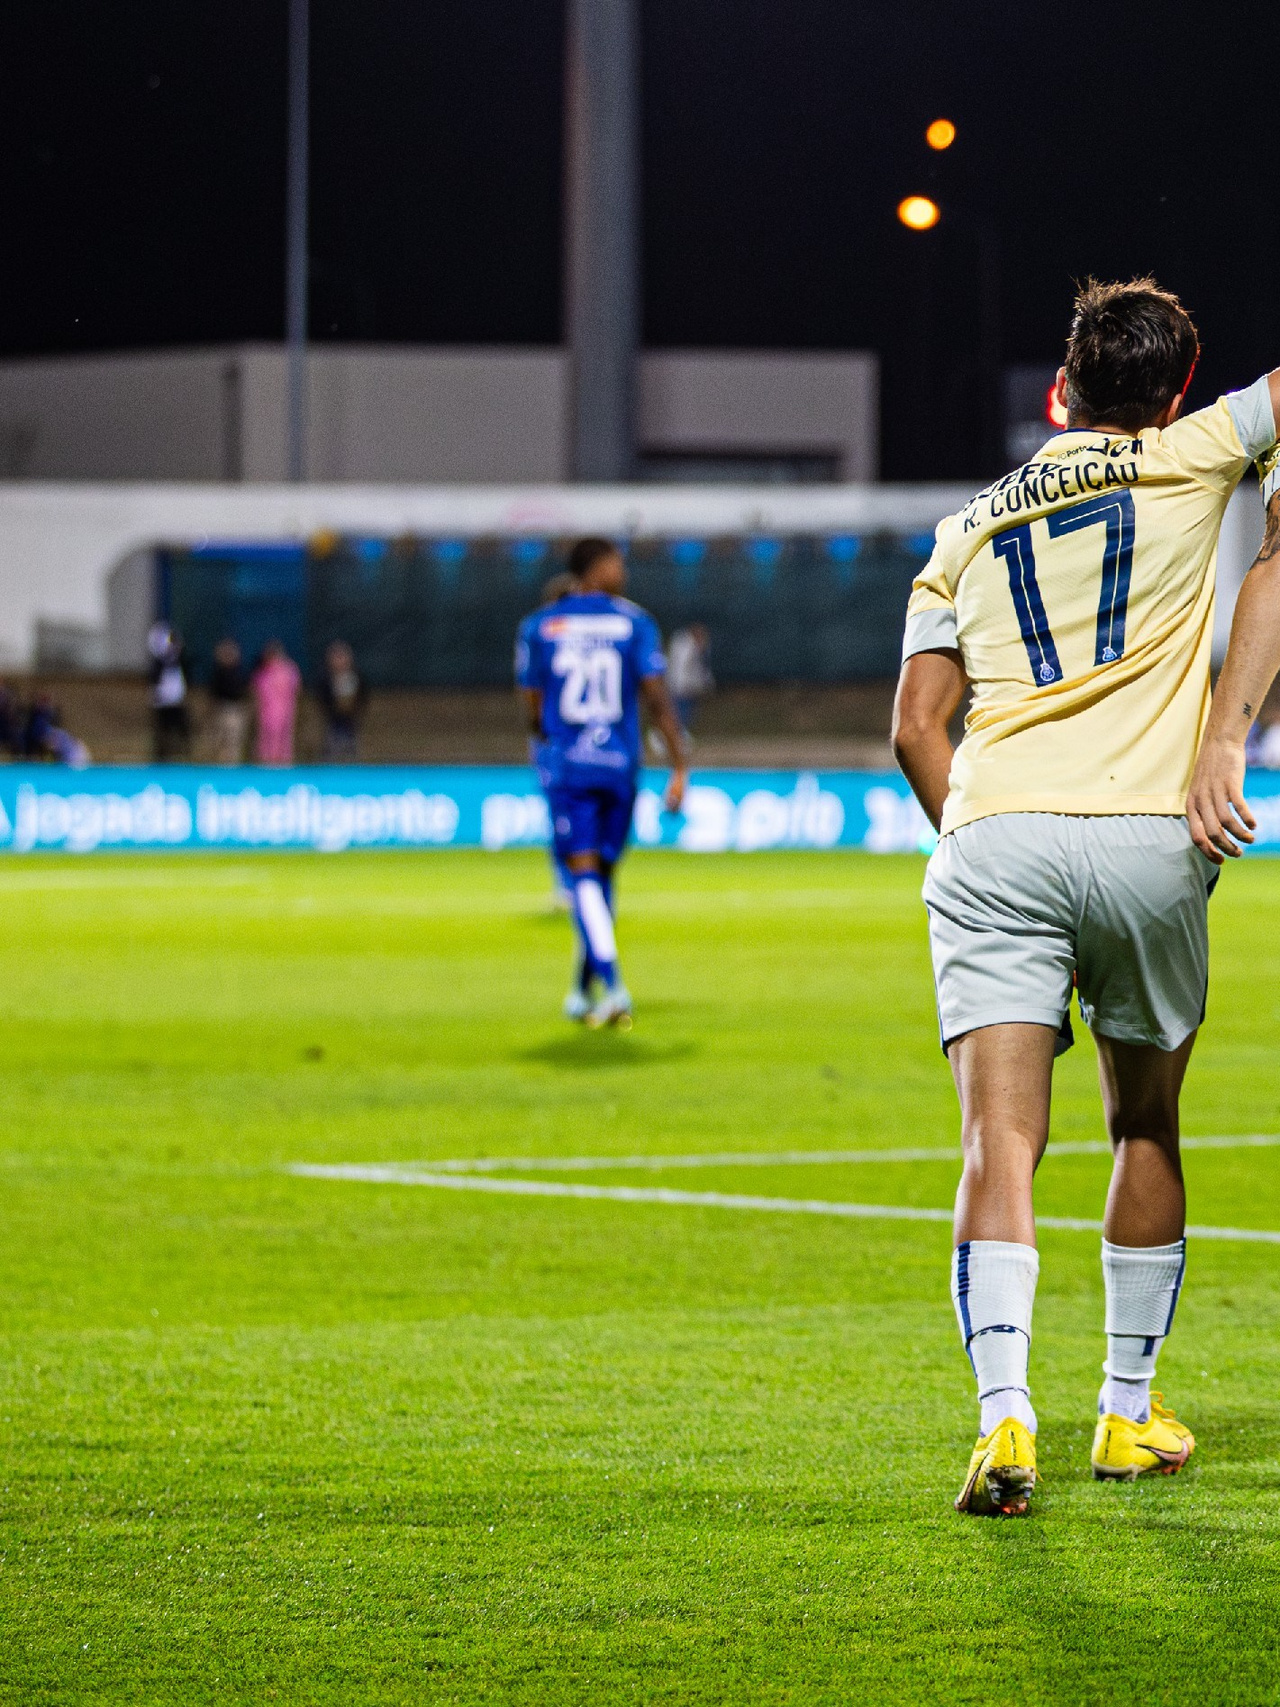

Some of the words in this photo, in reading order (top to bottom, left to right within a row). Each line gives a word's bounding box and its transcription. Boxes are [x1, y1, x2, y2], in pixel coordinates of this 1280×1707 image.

[992, 487, 1136, 688] 17
[551, 647, 624, 725] 20
[14, 782, 193, 853] jogada
[195, 783, 461, 853] inteligente
